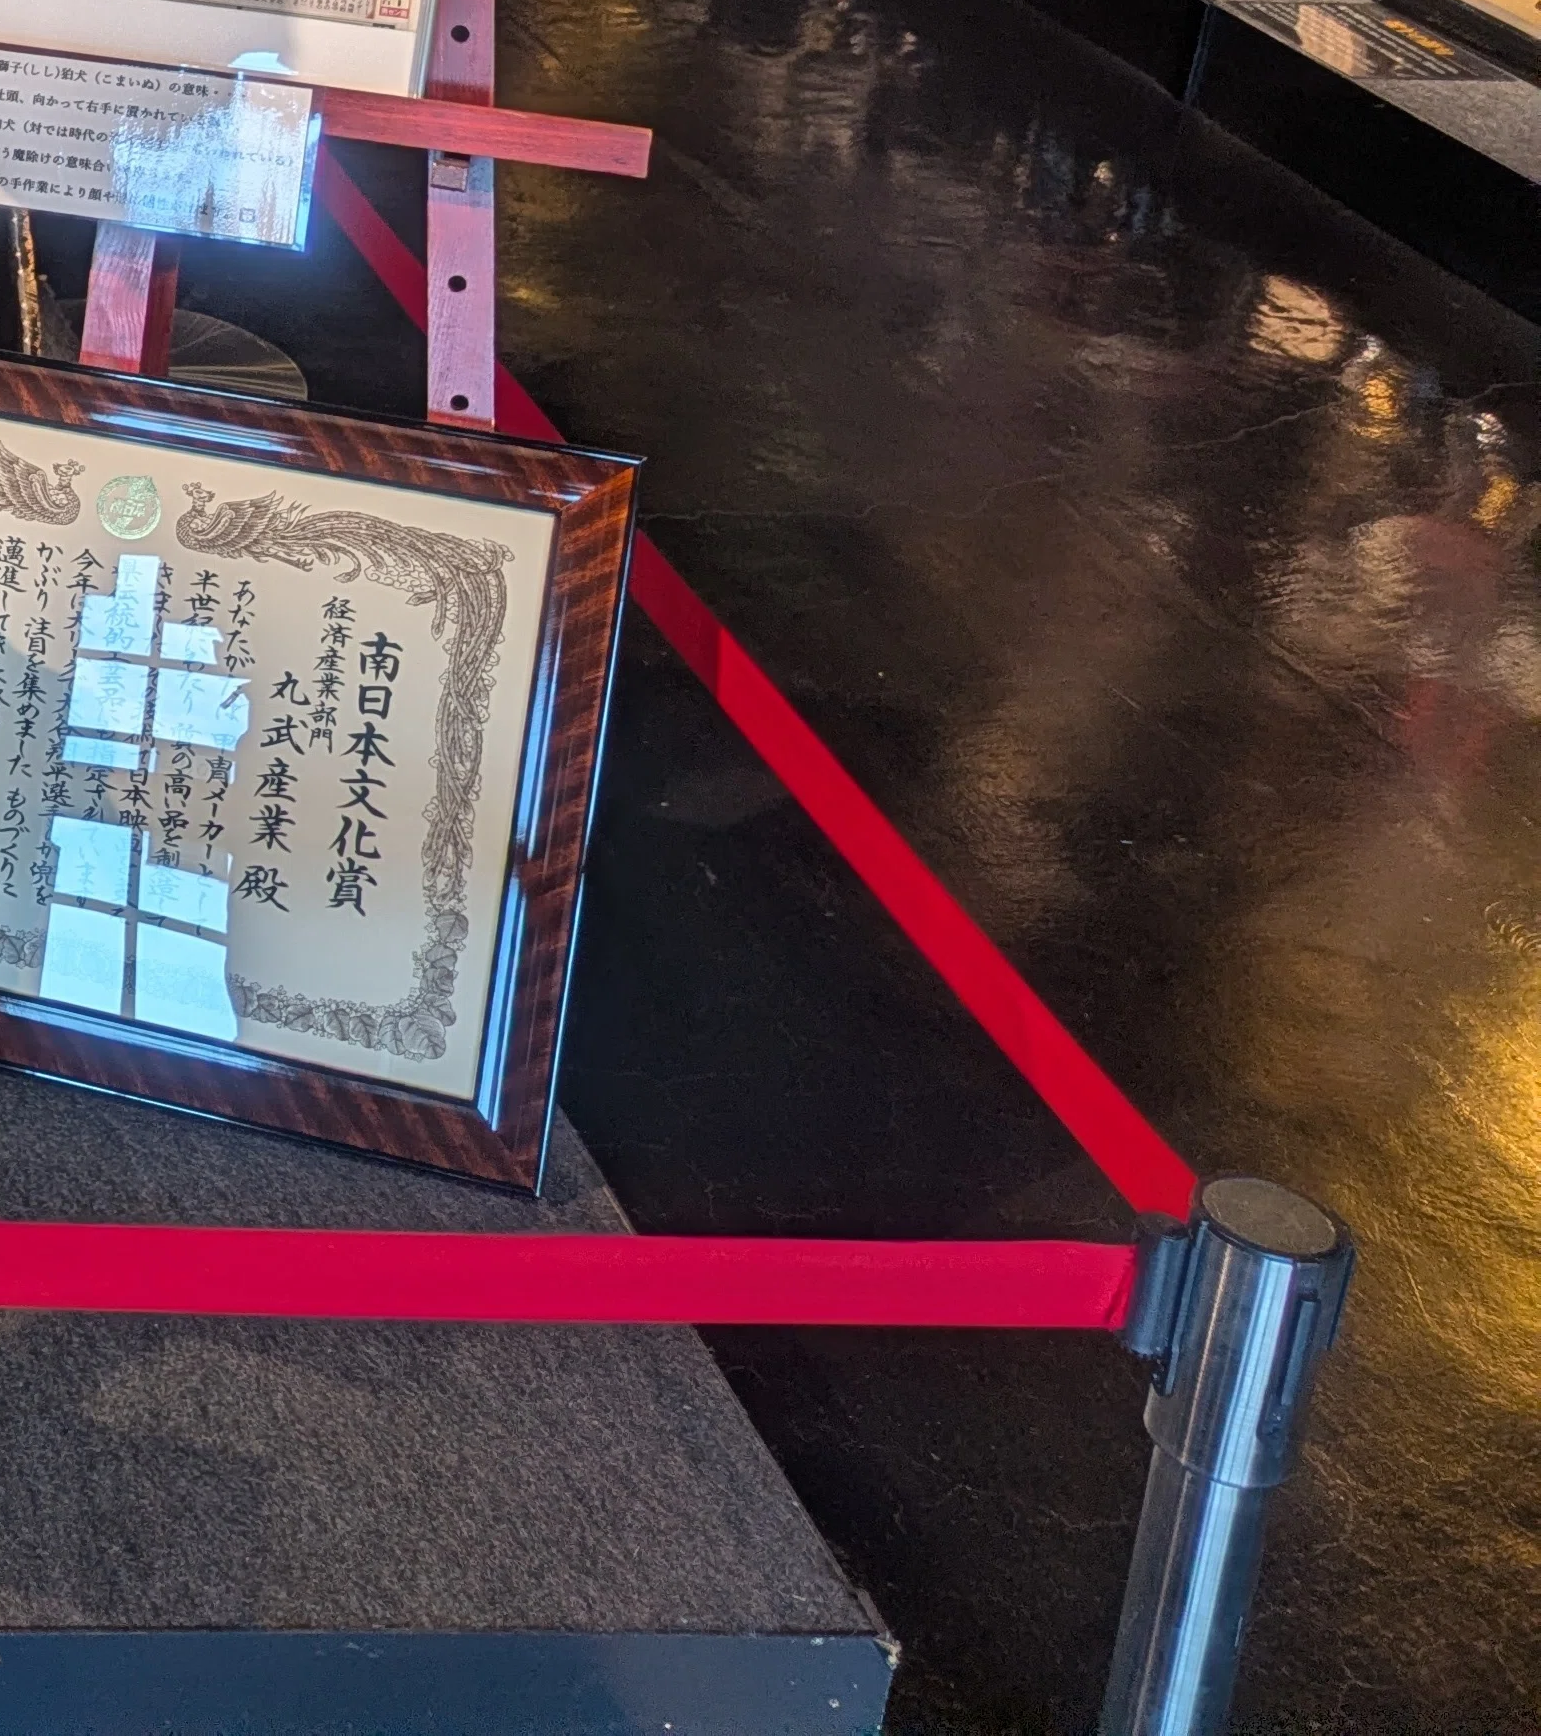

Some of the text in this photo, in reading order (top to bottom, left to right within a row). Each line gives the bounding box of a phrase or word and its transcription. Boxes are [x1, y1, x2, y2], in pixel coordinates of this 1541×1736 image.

[231, 670, 311, 913] 丸武産業 殿
[307, 595, 357, 754] 経済産業部門
[325, 631, 403, 917] 南日本文化賞
